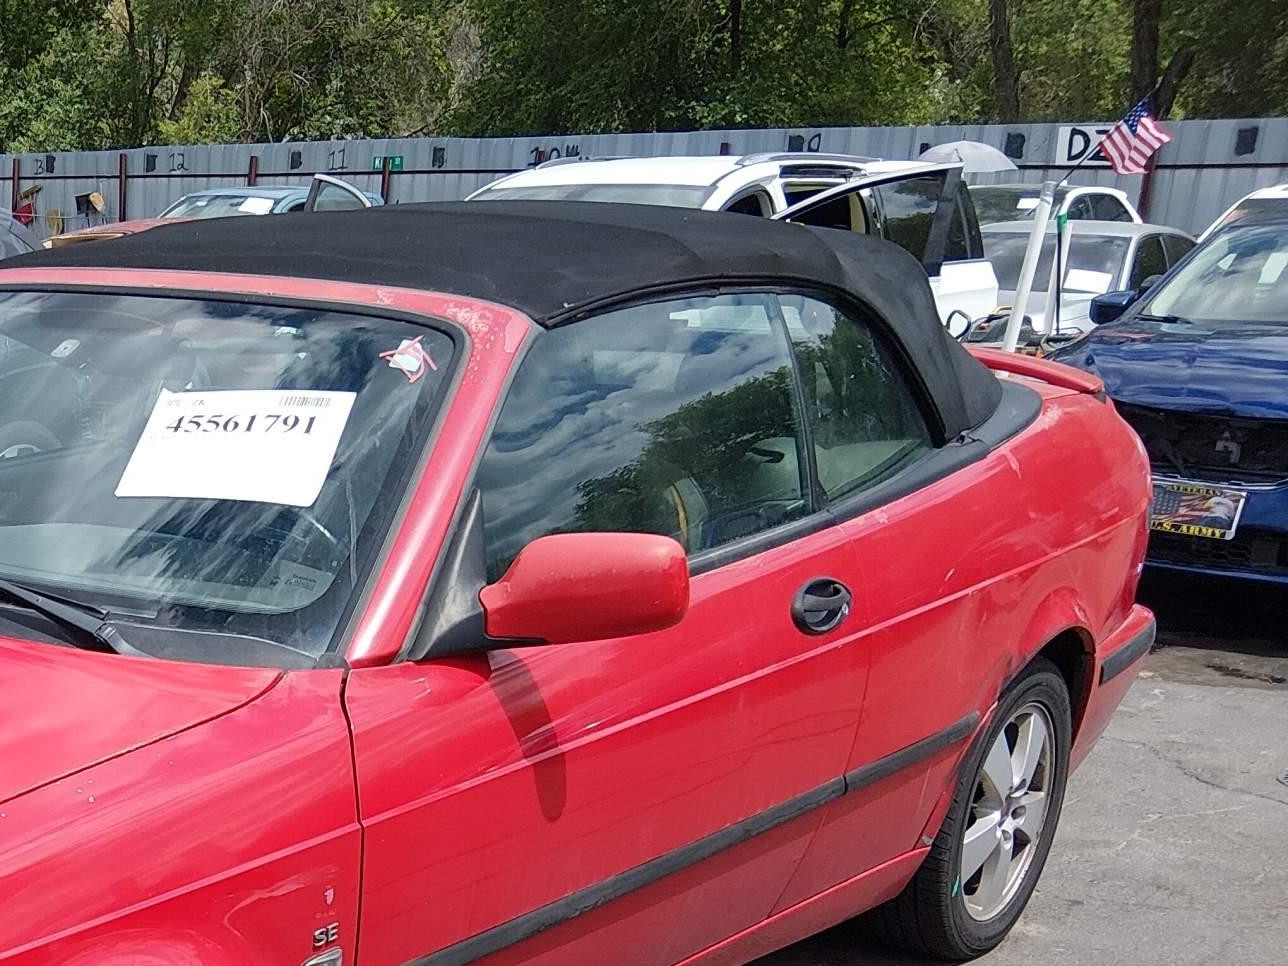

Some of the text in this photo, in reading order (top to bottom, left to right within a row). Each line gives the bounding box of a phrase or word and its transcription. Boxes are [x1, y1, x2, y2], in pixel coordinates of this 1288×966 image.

[168, 152, 189, 172] 12
[327, 148, 348, 170] 11
[165, 413, 316, 434] 45561791
[1179, 522, 1223, 538] ARMY
[313, 921, 339, 947] SE
